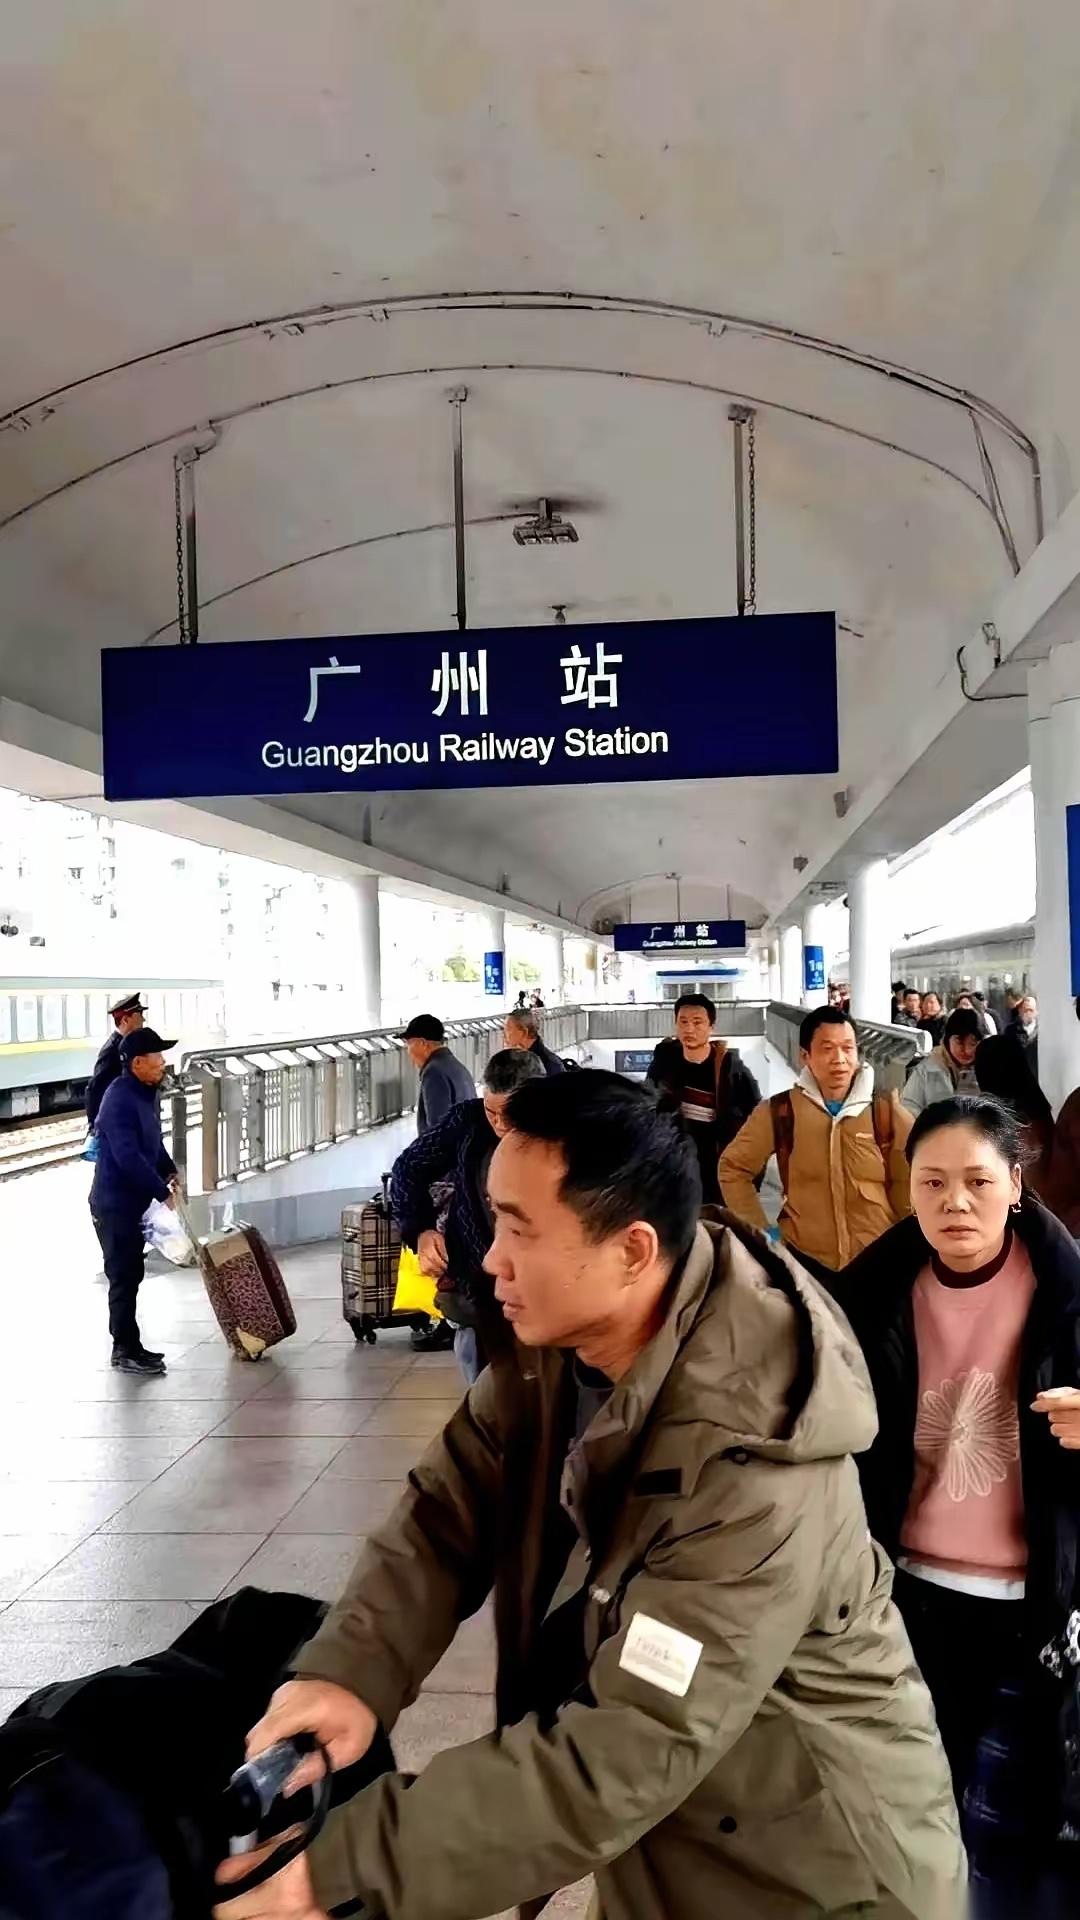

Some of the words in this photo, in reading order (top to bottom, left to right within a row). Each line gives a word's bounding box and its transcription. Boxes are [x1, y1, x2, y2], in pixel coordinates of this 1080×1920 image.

[303, 642, 623, 723] 广州站
[261, 737, 429, 773] Guangzhou
[439, 728, 556, 763] Railway
[564, 727, 669, 756] Station
[649, 923, 709, 939] 广州站
